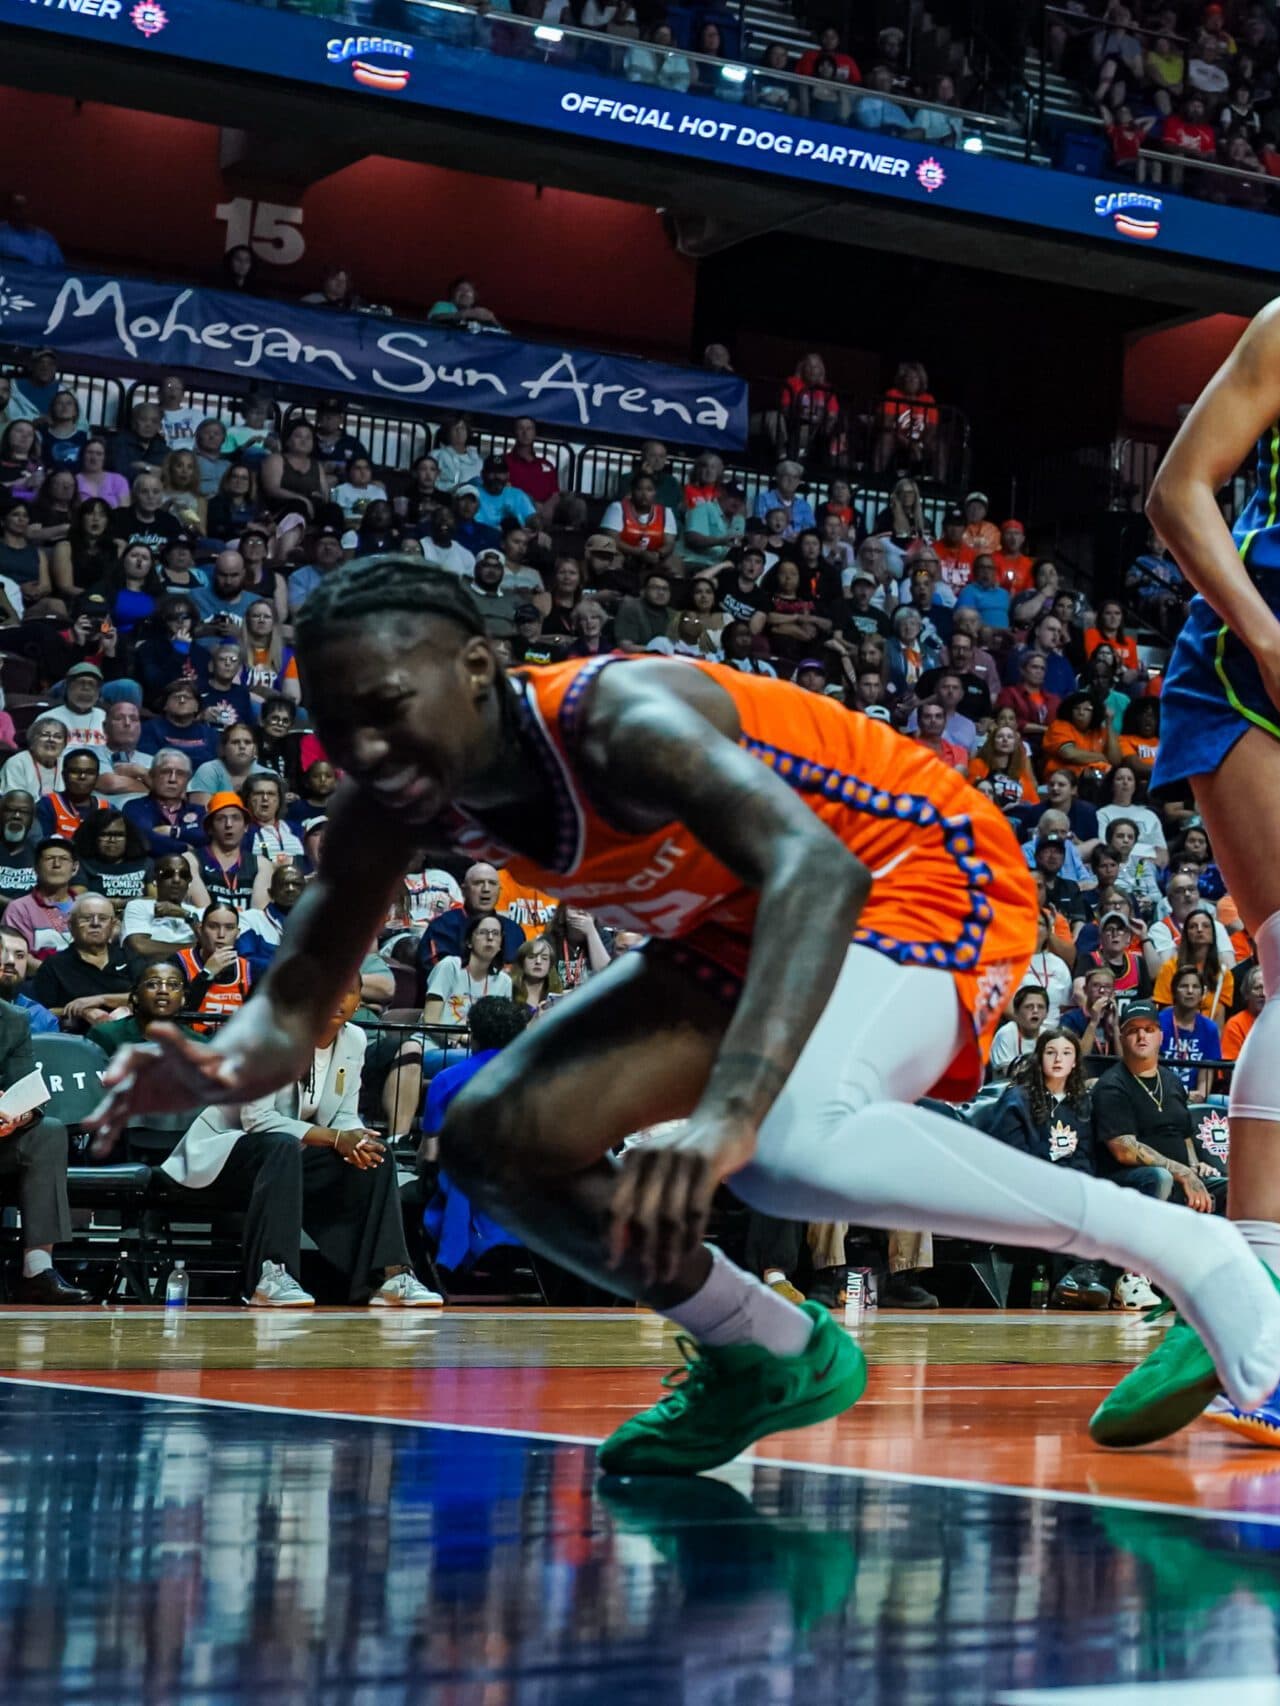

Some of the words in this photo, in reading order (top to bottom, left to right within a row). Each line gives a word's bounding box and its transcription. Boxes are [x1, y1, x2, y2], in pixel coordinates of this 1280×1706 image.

[561, 92, 674, 131] OFFICIAL
[678, 114, 736, 142] HOT
[737, 127, 793, 155] DOG
[795, 140, 911, 178] PARTNER
[215, 198, 305, 266] 15
[45, 277, 356, 382] Mohegan
[373, 332, 506, 394] Sun
[529, 353, 729, 431] Arena
